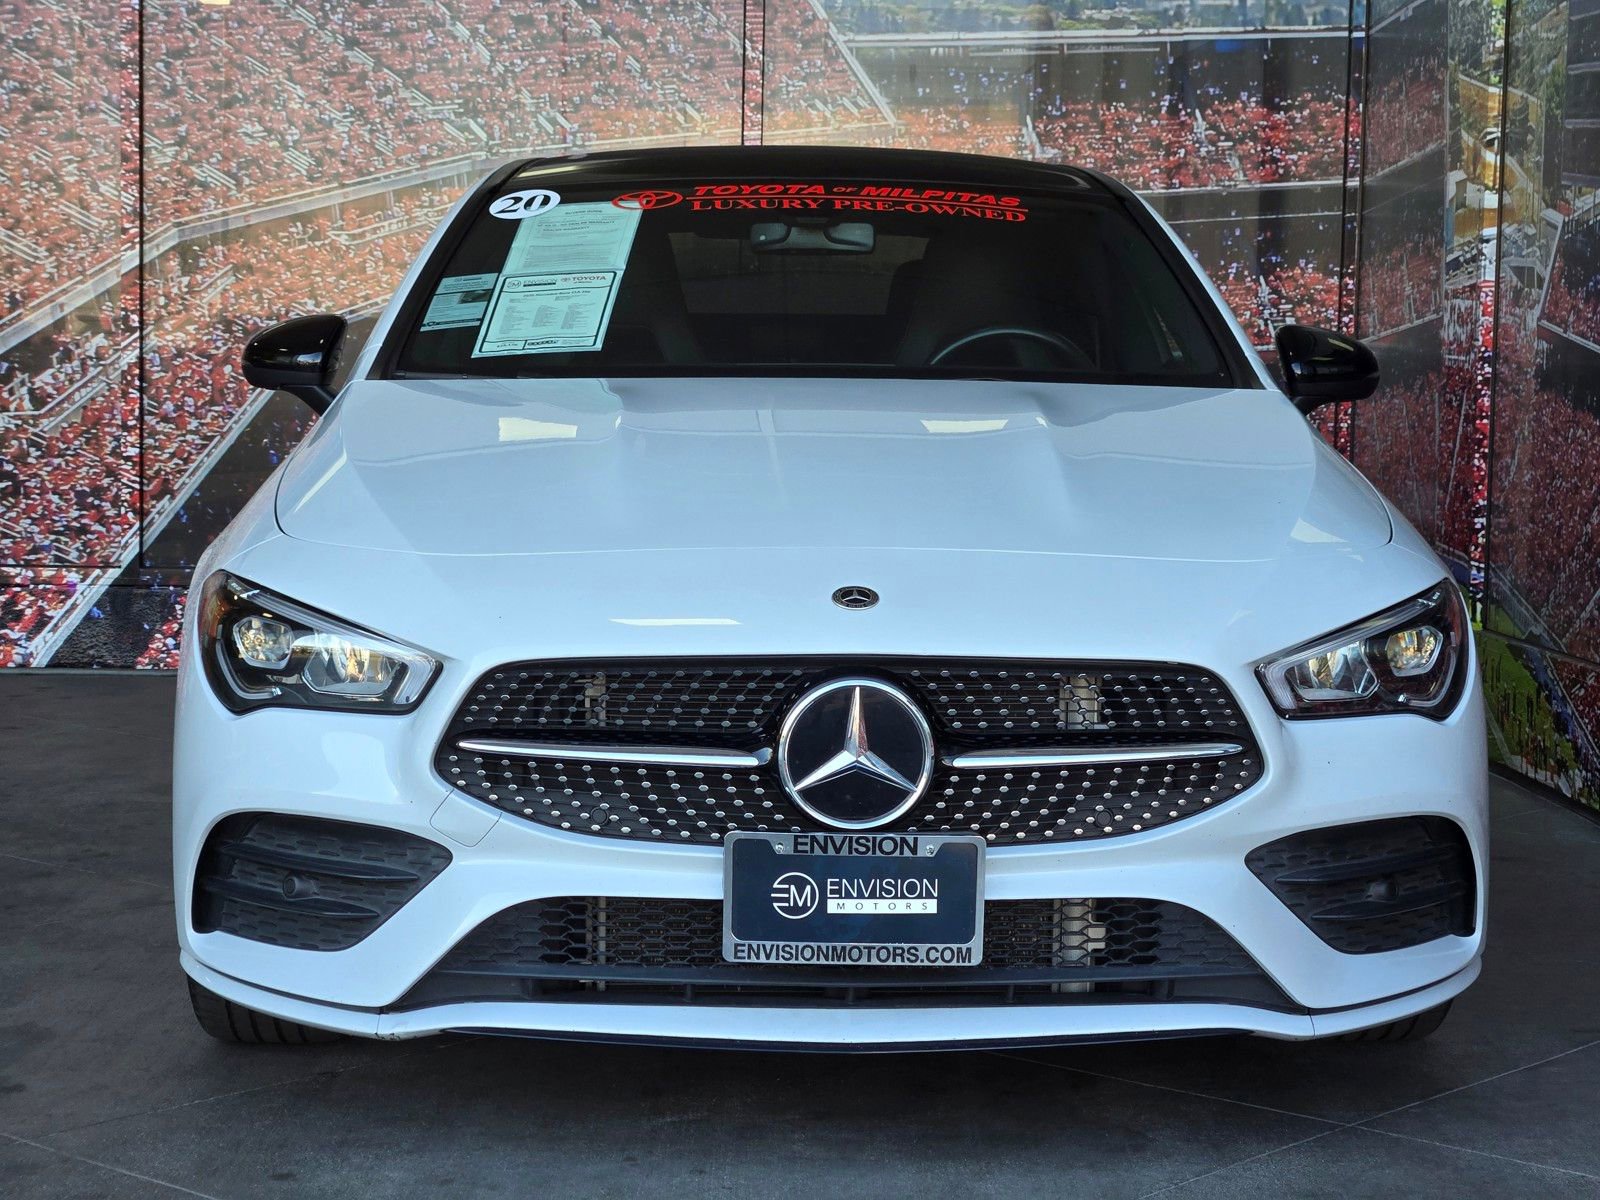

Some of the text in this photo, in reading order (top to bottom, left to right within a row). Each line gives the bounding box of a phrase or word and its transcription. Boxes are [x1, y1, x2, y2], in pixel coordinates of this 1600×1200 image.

[494, 194, 551, 214] 20
[694, 184, 825, 196] TOYOTA
[859, 185, 1021, 207] MILPITAS
[690, 199, 1027, 222] LUXURY PRE-OWNED
[792, 834, 919, 856] ENVISION
[826, 878, 939, 898] ENVISION
[836, 901, 929, 911] MOTORS
[732, 942, 973, 965] ENVISIONMOTORS.COM
